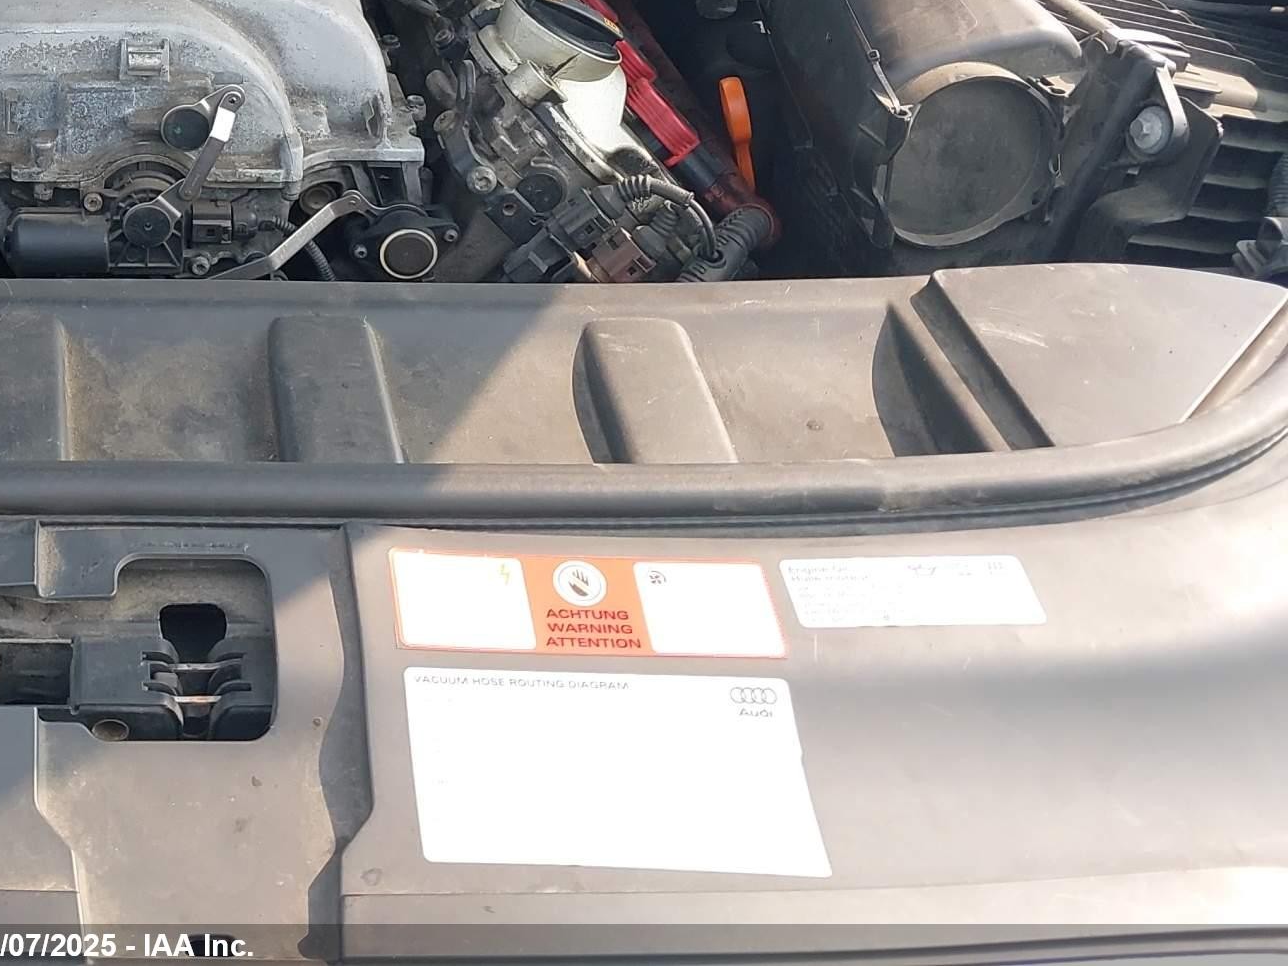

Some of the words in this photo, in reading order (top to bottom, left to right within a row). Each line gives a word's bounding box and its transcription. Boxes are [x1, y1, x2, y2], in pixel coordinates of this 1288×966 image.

[546, 608, 629, 620] ACHTUNG
[547, 623, 633, 634] WARNING
[546, 637, 641, 648] ATTENTION
[414, 675, 469, 685] VACUUM
[472, 677, 505, 687] HOSE
[509, 678, 565, 688] ROUTING
[569, 680, 630, 690] DIAGRAM
[739, 708, 773, 718] Audi
